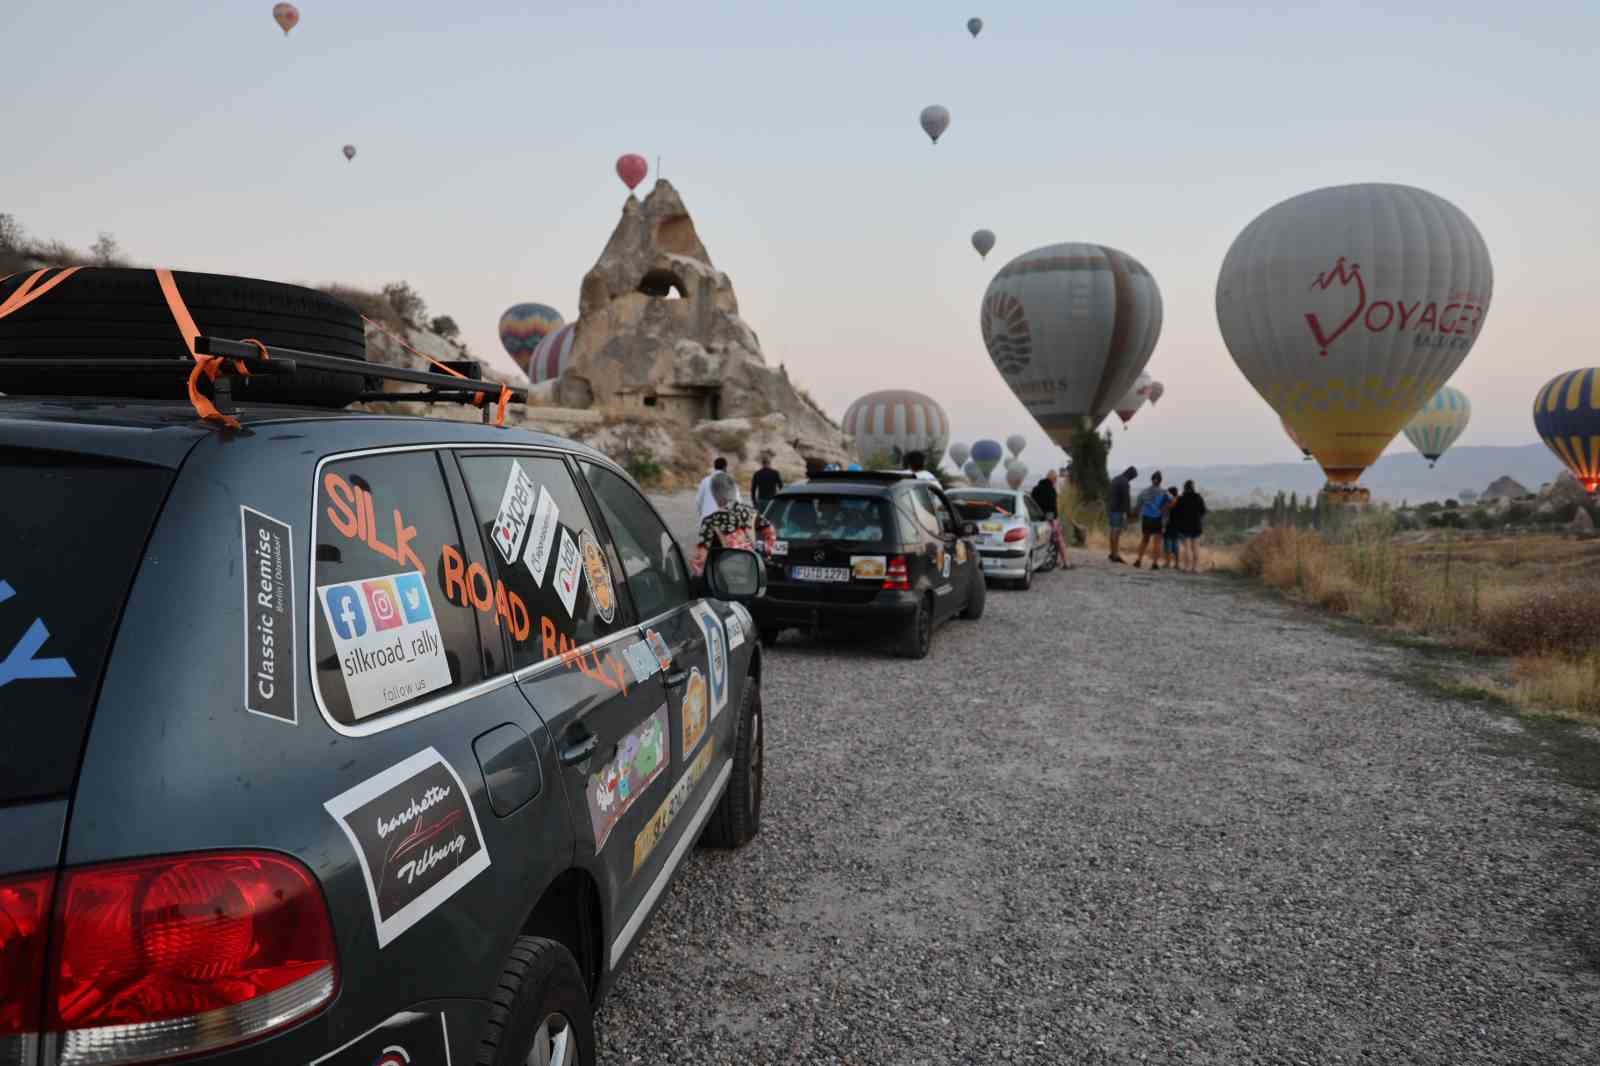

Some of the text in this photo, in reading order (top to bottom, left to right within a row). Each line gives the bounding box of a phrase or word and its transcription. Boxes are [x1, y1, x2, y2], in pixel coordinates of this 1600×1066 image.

[323, 472, 427, 576] SILK
[442, 543, 530, 641] ROAD
[255, 528, 274, 700] Classic Remise
[344, 629, 439, 677] silkroad_rally
[383, 679, 426, 704] follow us
[377, 785, 451, 839] barchetta
[397, 834, 466, 884] Tilburg
